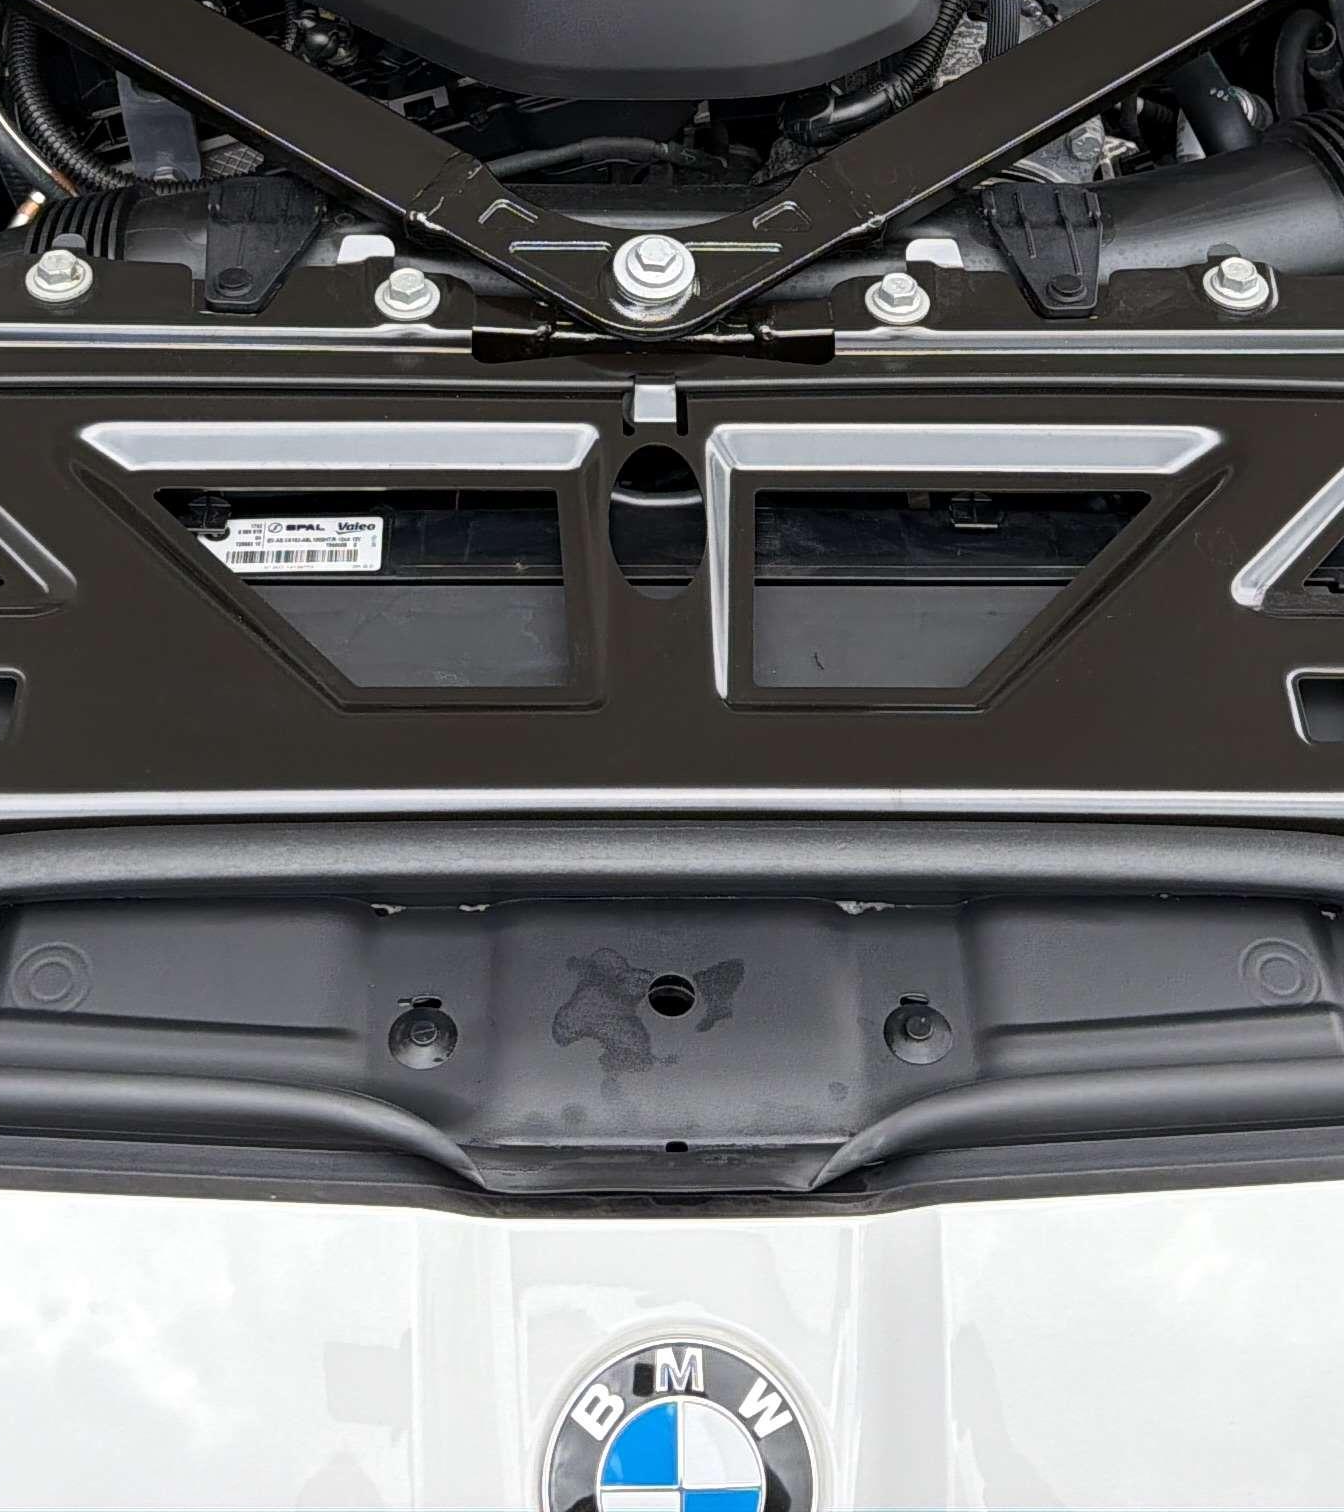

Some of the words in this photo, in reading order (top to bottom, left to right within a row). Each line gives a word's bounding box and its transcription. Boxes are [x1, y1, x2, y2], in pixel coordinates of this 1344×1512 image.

[285, 523, 325, 531] SPAL
[337, 522, 376, 531] Valeo
[571, 1346, 793, 1441] BMW
